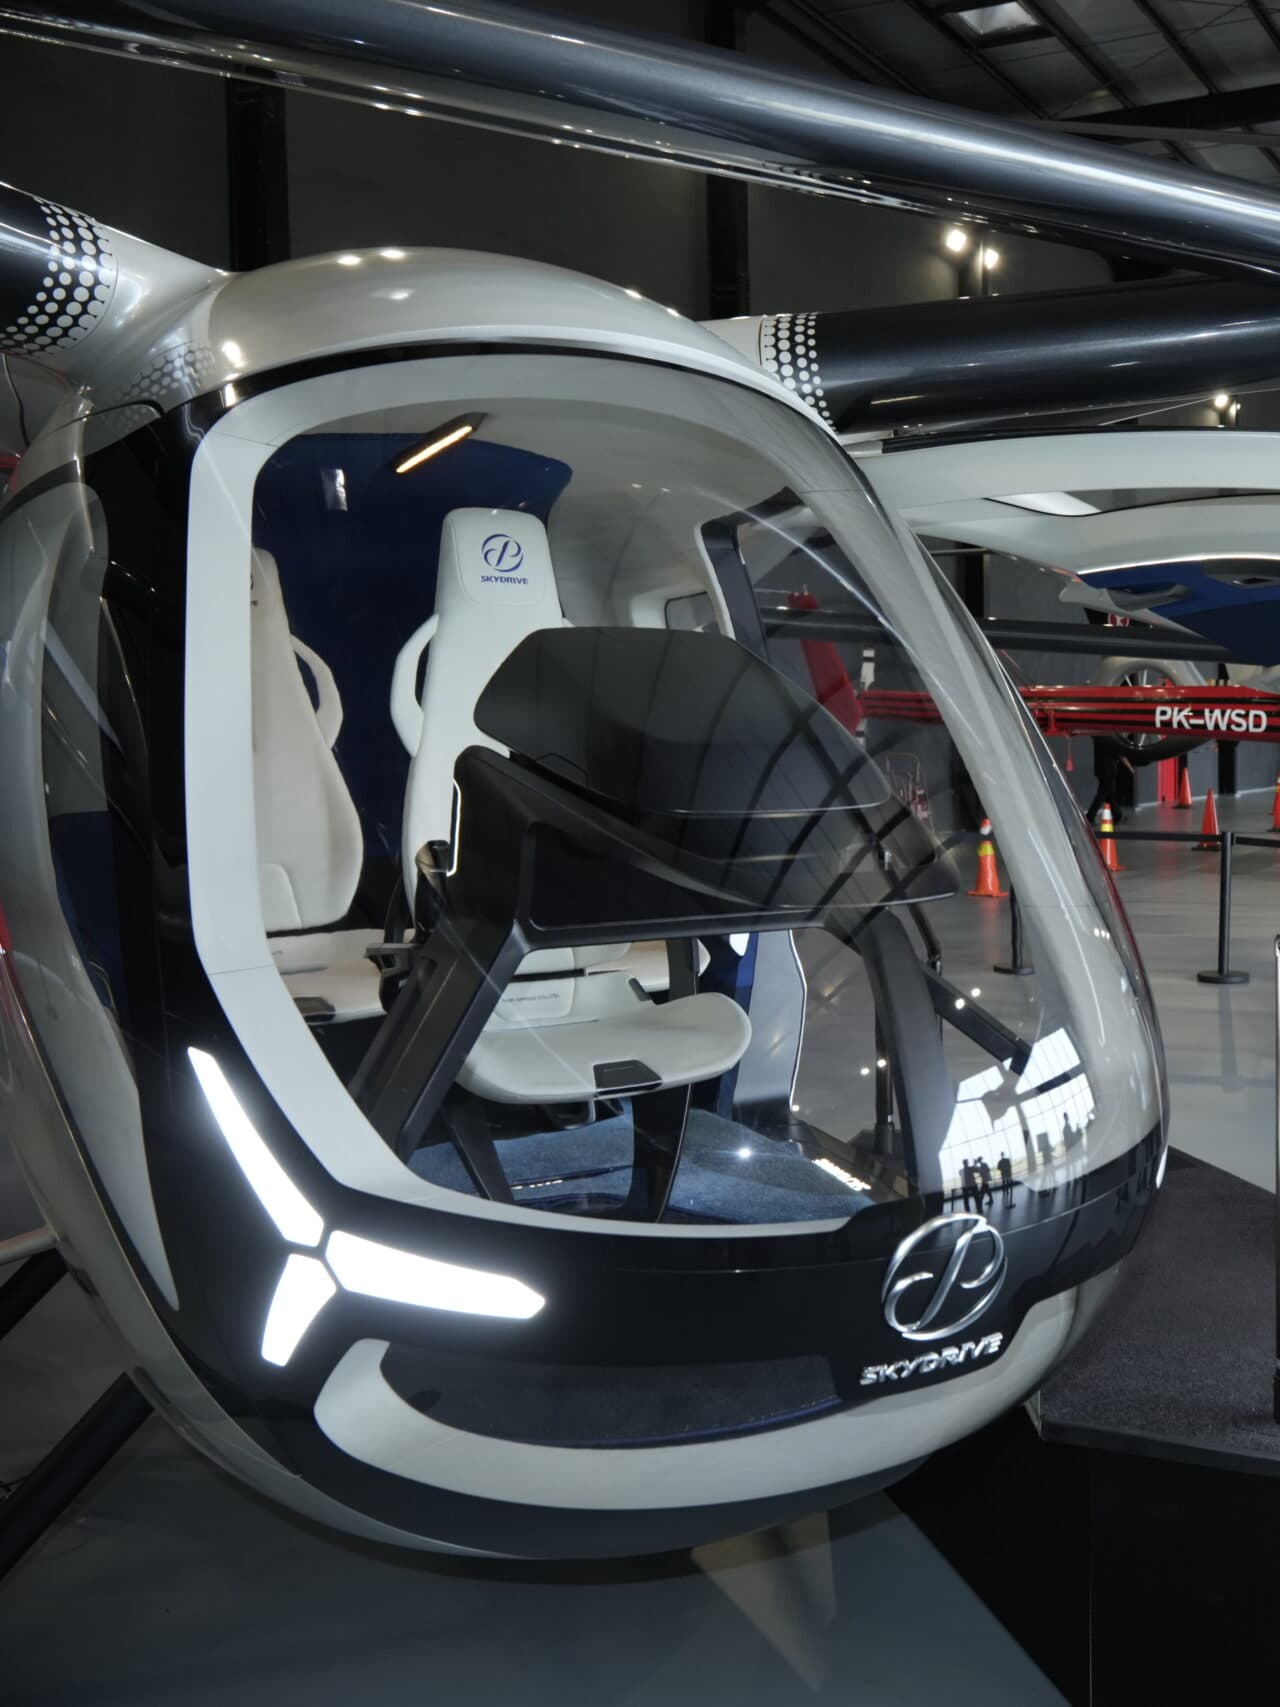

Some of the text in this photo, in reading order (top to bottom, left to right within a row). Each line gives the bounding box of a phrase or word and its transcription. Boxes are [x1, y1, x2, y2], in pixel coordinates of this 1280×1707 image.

[480, 575, 529, 585] SKYDRIVE
[1155, 706, 1268, 733] PK-WSD
[859, 1332, 1003, 1385] SKYDRIVE
